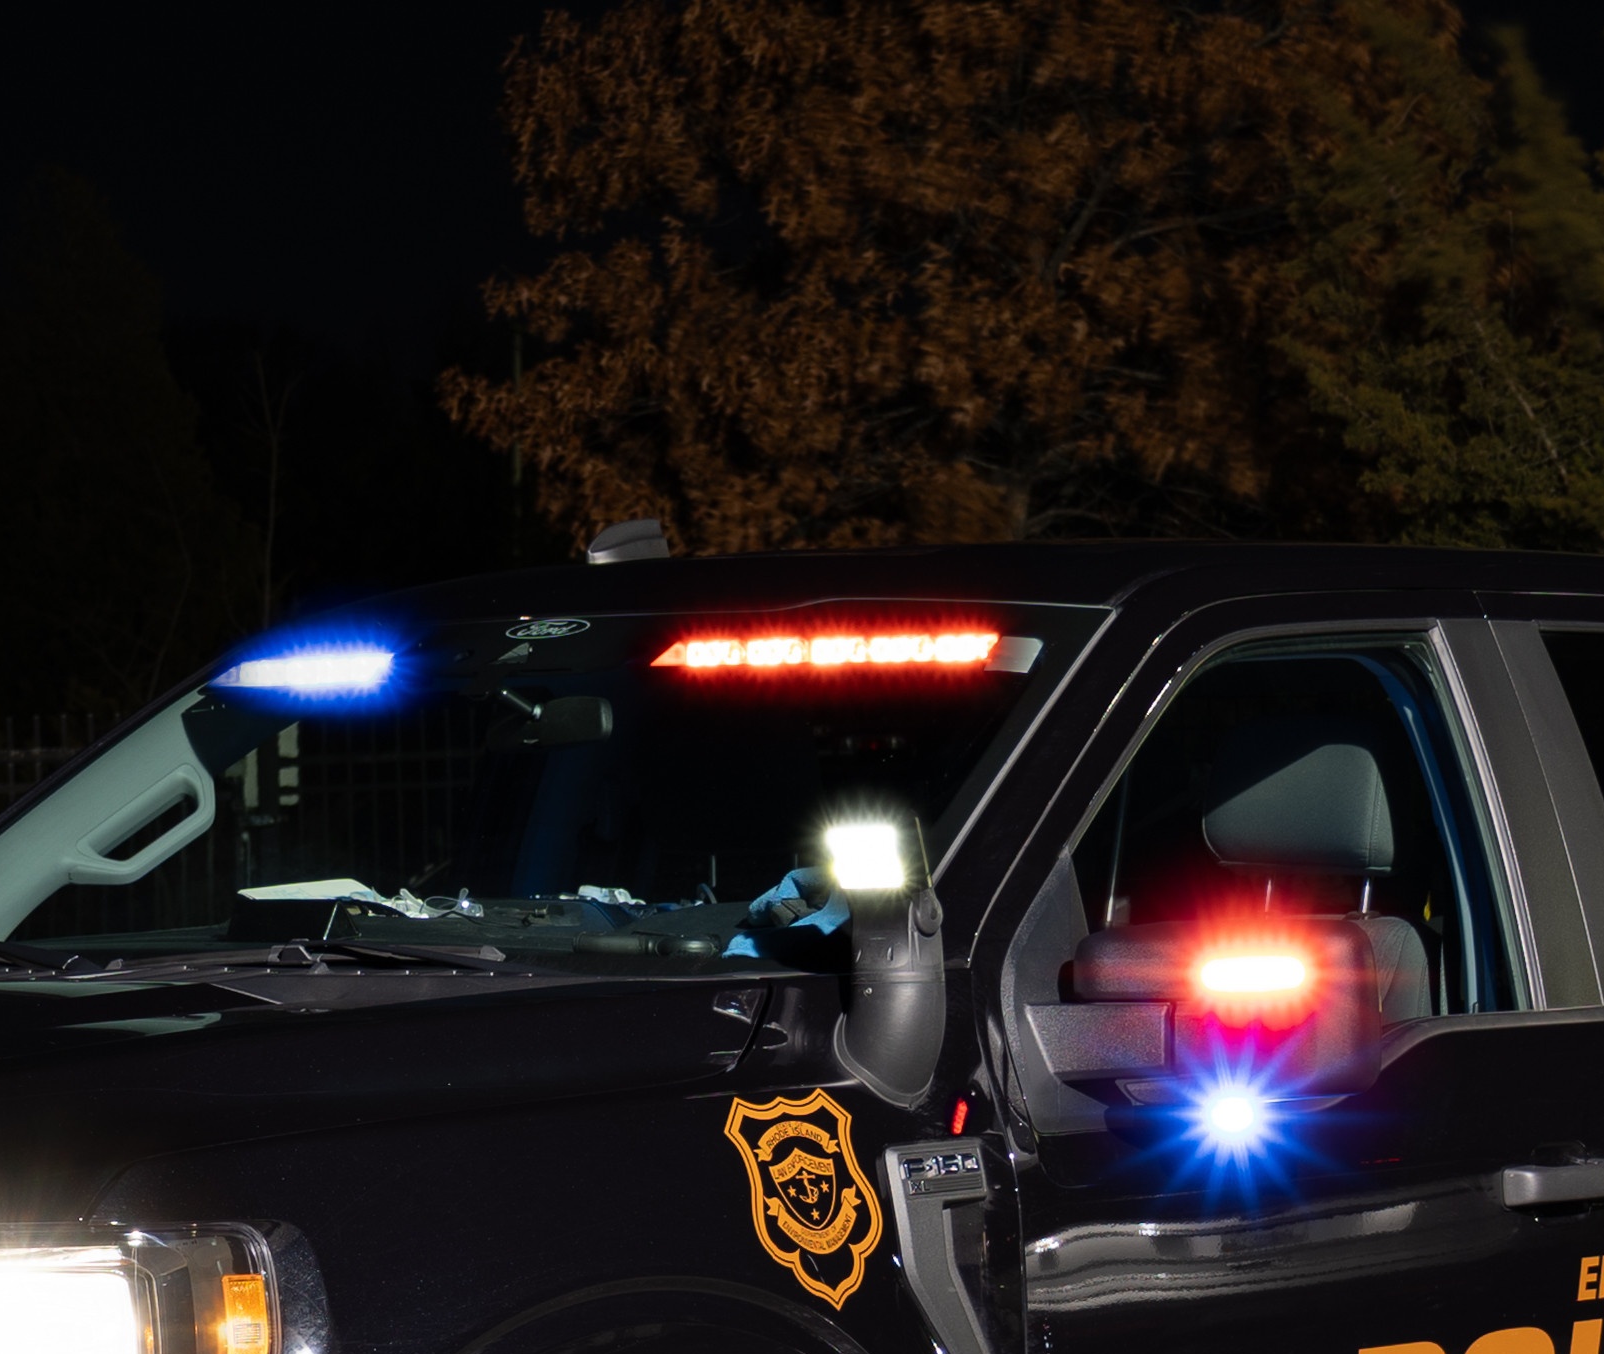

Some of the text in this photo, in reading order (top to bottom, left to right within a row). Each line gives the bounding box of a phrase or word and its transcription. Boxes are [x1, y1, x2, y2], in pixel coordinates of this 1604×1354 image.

[766, 1126, 823, 1147] RHODE ISLAND
[786, 1154, 833, 1174] ENFORCEMENT
